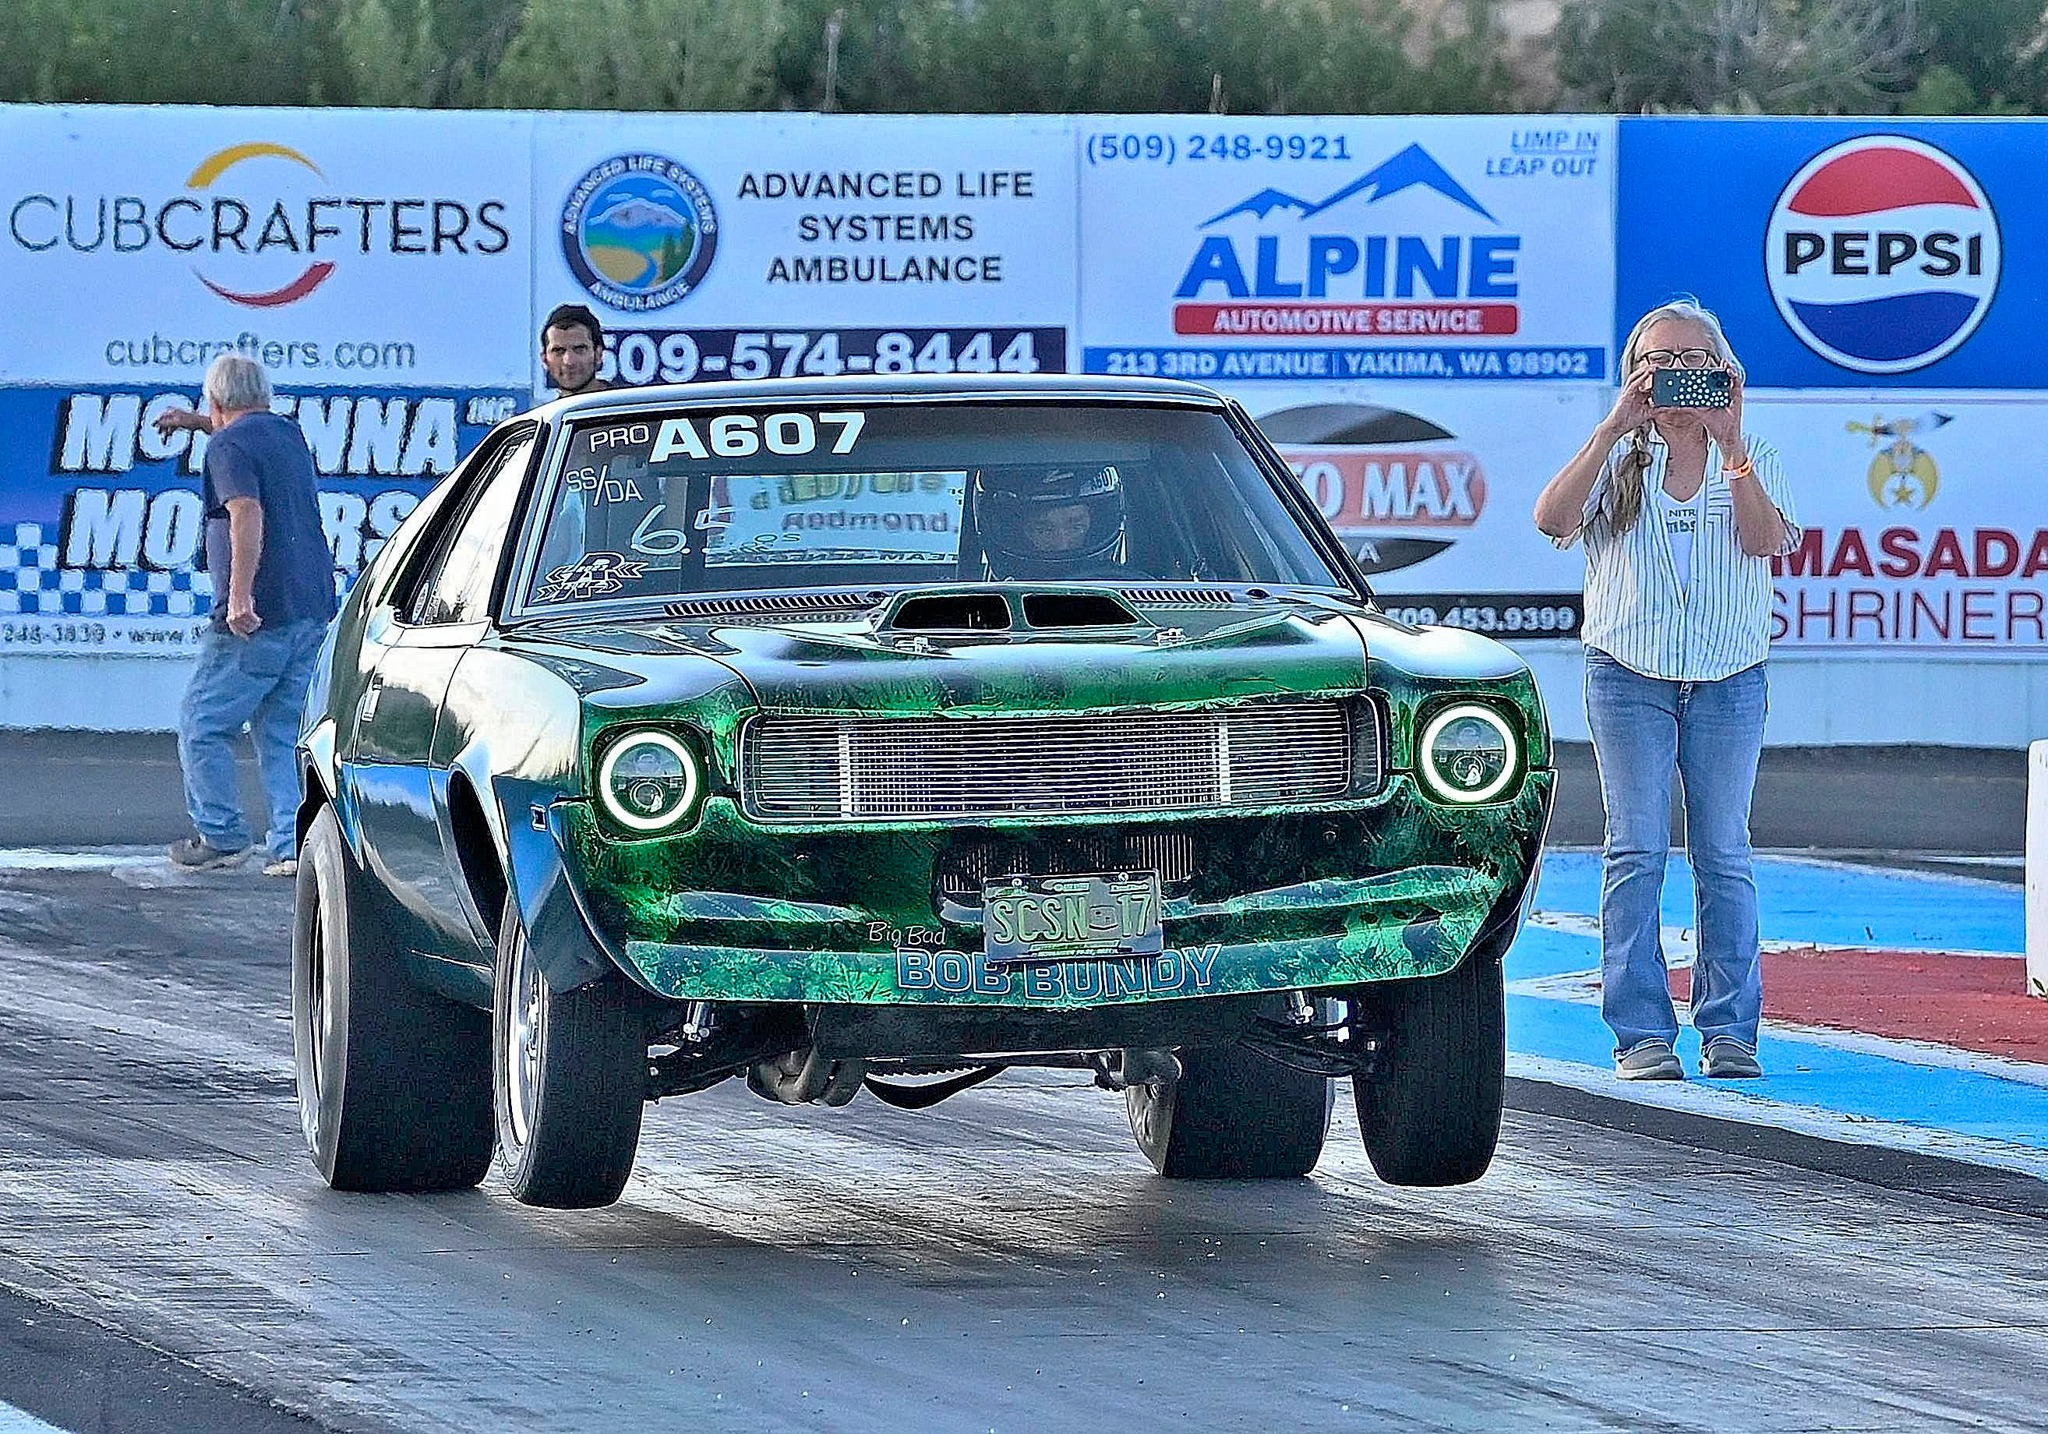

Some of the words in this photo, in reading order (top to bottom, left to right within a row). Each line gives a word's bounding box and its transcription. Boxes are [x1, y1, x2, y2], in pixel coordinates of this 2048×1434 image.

[1087, 134, 1176, 164] (509)
[1188, 134, 1350, 160] 248-9921
[1511, 130, 1569, 149] LIMP
[1575, 130, 1599, 149] IN
[627, 154, 668, 171] LIFE
[1486, 157, 1544, 177] LEAP
[1551, 157, 1597, 177] OUT
[738, 172, 943, 200] ADVANCED
[956, 171, 1035, 197] LIFE
[9, 194, 510, 254] CUBCRAFTERS
[800, 216, 975, 242] SYSTEMS
[767, 257, 1004, 283] AMBULANCE
[1175, 236, 1521, 298] ALPINE
[1785, 232, 1982, 276] PEPSI
[1213, 308, 1372, 334] AUTOMOTIVE
[1375, 308, 1484, 334] SERVICE
[1106, 352, 1157, 376] 213
[1162, 351, 1217, 376] 3RD
[1222, 351, 1328, 376] AVENUE
[1345, 352, 1454, 379] YAKIMA,
[1458, 352, 1502, 375] WA
[1506, 352, 1590, 376] 98902
[60, 393, 459, 474] MCNNA
[590, 425, 650, 453] PRO
[649, 412, 866, 463] A607
[565, 464, 644, 507] SS/DA
[1361, 461, 1477, 520] MAX
[63, 488, 421, 571] MORS
[1772, 530, 2048, 578] MASADA
[866, 922, 902, 948] Big
[905, 925, 946, 945] Bad
[993, 899, 1089, 943] SCSN
[1117, 892, 1153, 937] 17
[897, 947, 1012, 993] BOB
[1024, 944, 1221, 999] BUNDY
